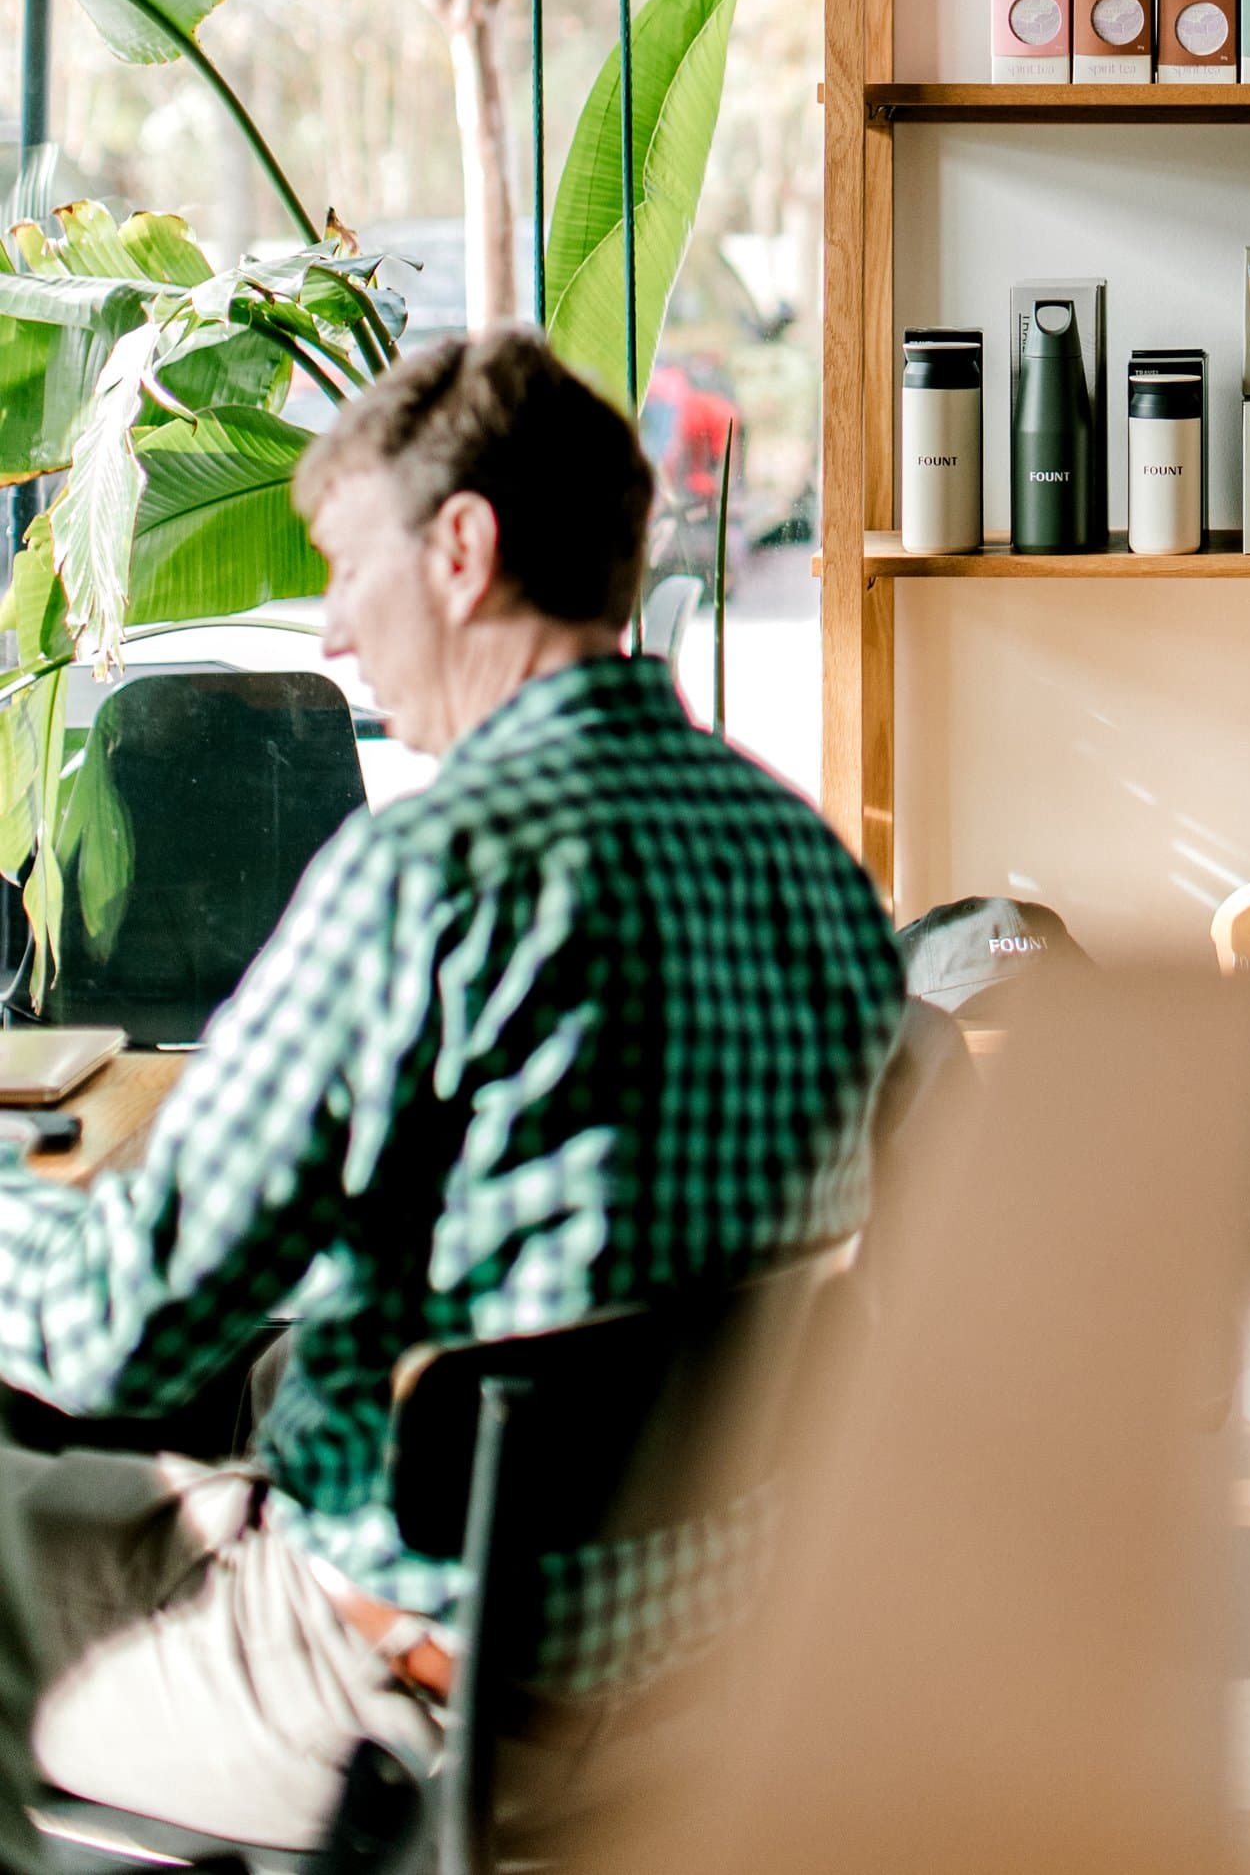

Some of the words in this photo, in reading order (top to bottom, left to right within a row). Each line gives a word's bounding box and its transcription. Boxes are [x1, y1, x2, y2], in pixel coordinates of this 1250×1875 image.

[918, 456, 958, 466] FOUNT
[1143, 465, 1183, 476] FOUNT
[1030, 471, 1070, 482] FOUNT
